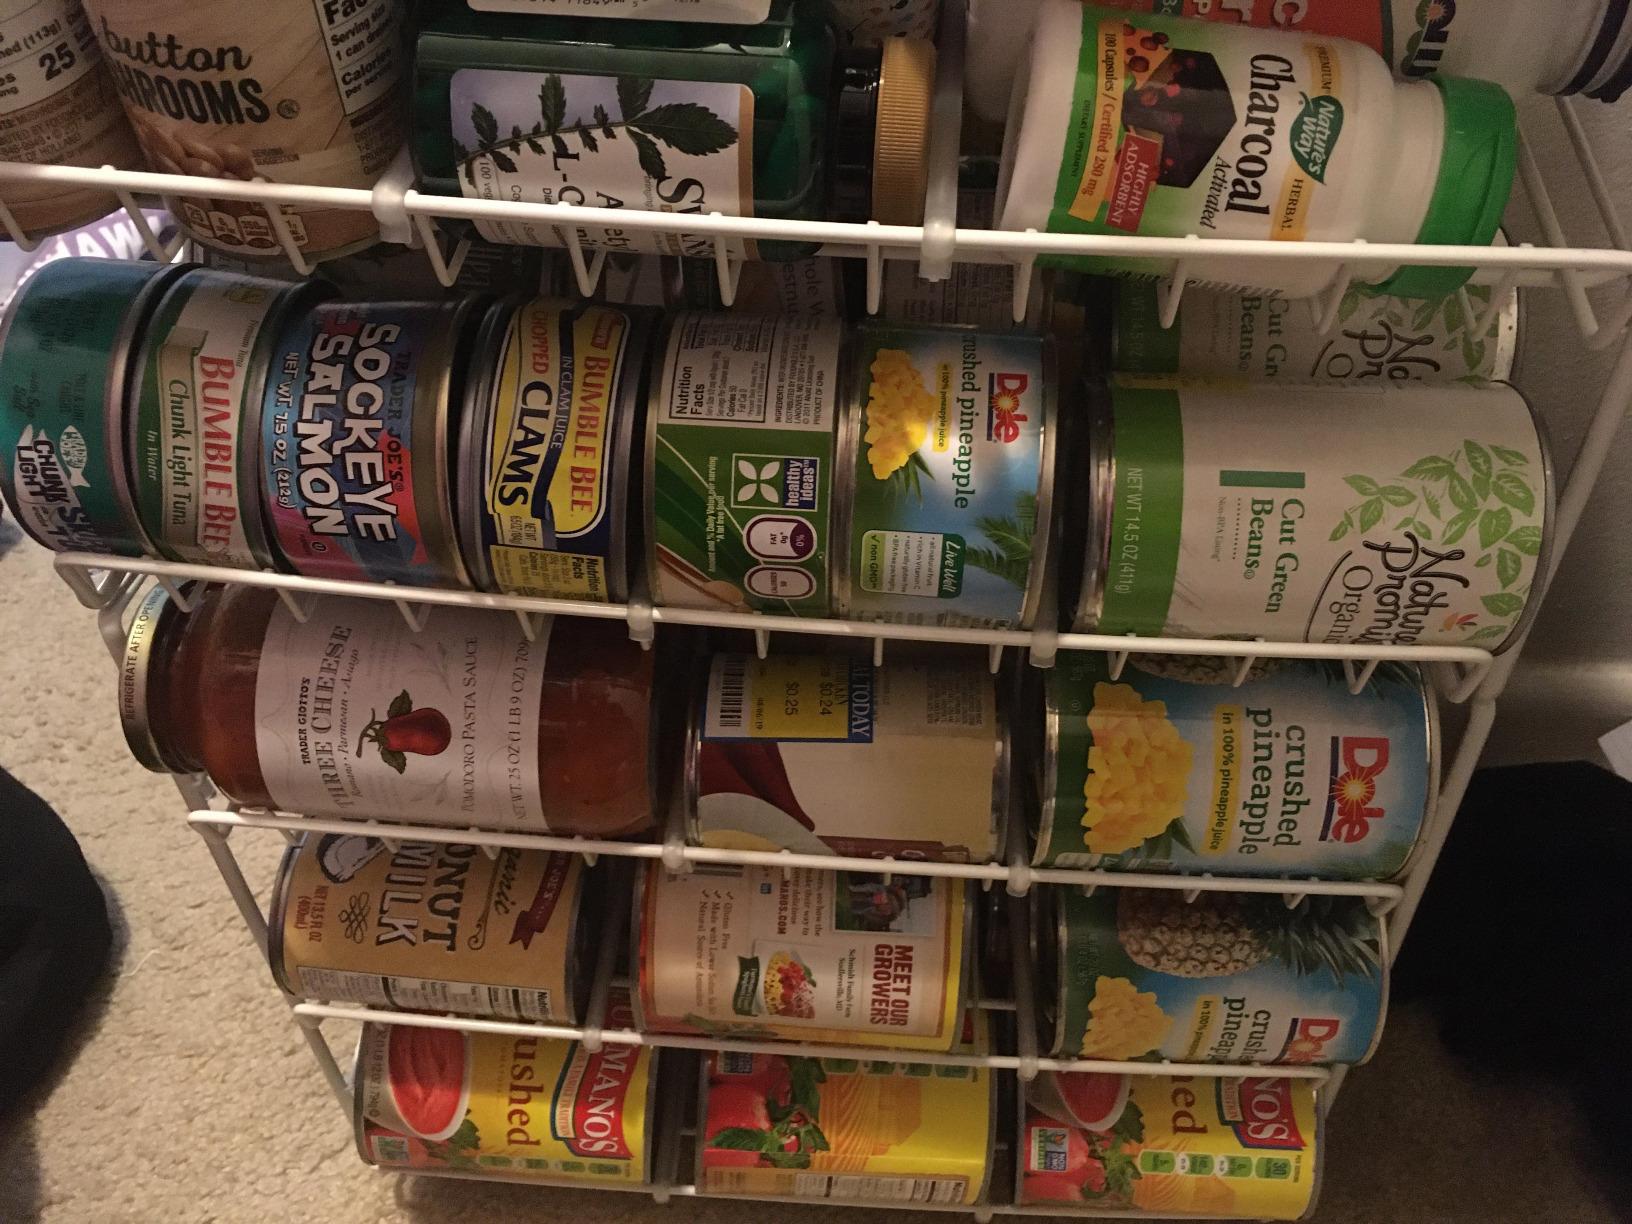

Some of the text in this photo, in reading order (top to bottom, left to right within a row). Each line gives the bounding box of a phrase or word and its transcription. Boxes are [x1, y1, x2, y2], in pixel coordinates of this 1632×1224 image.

[40, 42, 75, 81] 25
[101, 16, 253, 72] button
[1101, 49, 1118, 92] Capsules
[1095, 102, 1116, 153] Certified
[1223, 53, 1297, 217] Charcoal
[1293, 115, 1319, 160] Way
[1306, 100, 1336, 175] Nature's
[1080, 178, 1099, 198] mg
[1089, 154, 1111, 177] 280
[1109, 142, 1139, 225] ADSORBENT
[1128, 161, 1151, 216] HIGHLY
[1199, 155, 1234, 230] Activated
[1279, 178, 1305, 232] HERBAL
[1265, 297, 1289, 338] Cut
[283, 351, 299, 377] NET
[386, 351, 412, 424] TRADER
[675, 365, 693, 415] Nutrition
[557, 372, 571, 411] CLAM
[690, 383, 705, 415] Facts
[938, 390, 949, 428] pineapple
[990, 371, 1029, 444] Dole
[147, 430, 159, 481] In Water
[166, 378, 193, 525] Chunk Light Tuna
[199, 355, 237, 545] BUMBLE BEE
[272, 439, 287, 464] OZ
[296, 331, 354, 536] SALMON
[332, 322, 402, 542] SOCKEYE
[498, 380, 553, 507] CLAMS
[549, 413, 569, 449] JUICE
[569, 355, 611, 513] BUMBLE BEE
[937, 428, 948, 449] juice
[952, 396, 980, 510] pineapple
[18, 446, 46, 497] LIGHT
[34, 440, 71, 504] CHUNK
[272, 466, 298, 510] (212g)
[785, 459, 803, 507] healthy
[769, 533, 778, 545] FAT
[869, 543, 880, 561] non
[1114, 467, 1143, 594] NET WT 14.5 OZ (411g)
[1243, 497, 1275, 569] Beans
[1264, 497, 1306, 614] Cut Green
[572, 556, 586, 580] Facts
[942, 540, 962, 593] Live Well
[128, 623, 147, 654] AFTER
[124, 655, 138, 720] REFRIGERATE
[510, 666, 528, 693] OZ)
[784, 681, 800, 716] $0.25
[819, 681, 833, 716] $0.24
[297, 676, 311, 765] TRADER GIOTTO'S
[310, 625, 354, 809] THREE CHEESE
[337, 698, 350, 754] Parmesan
[461, 637, 478, 814] POMODORO PASTA SAUCE
[507, 707, 521, 726] LB
[850, 683, 872, 738] TODAY
[507, 743, 520, 764] OZ
[509, 766, 521, 780] 25
[1209, 712, 1235, 850] in 100% pineapple juice
[1238, 707, 1280, 855] pineapple
[1272, 725, 1312, 848] crushed
[1331, 736, 1391, 844] Dole
[312, 885, 329, 901] NET
[375, 842, 436, 948] MILK
[308, 930, 323, 943] OZ
[813, 924, 824, 937] the
[869, 943, 894, 1025] GROWERS
[888, 944, 914, 1027] MEET OUR
[1274, 1161, 1288, 1175] 30
